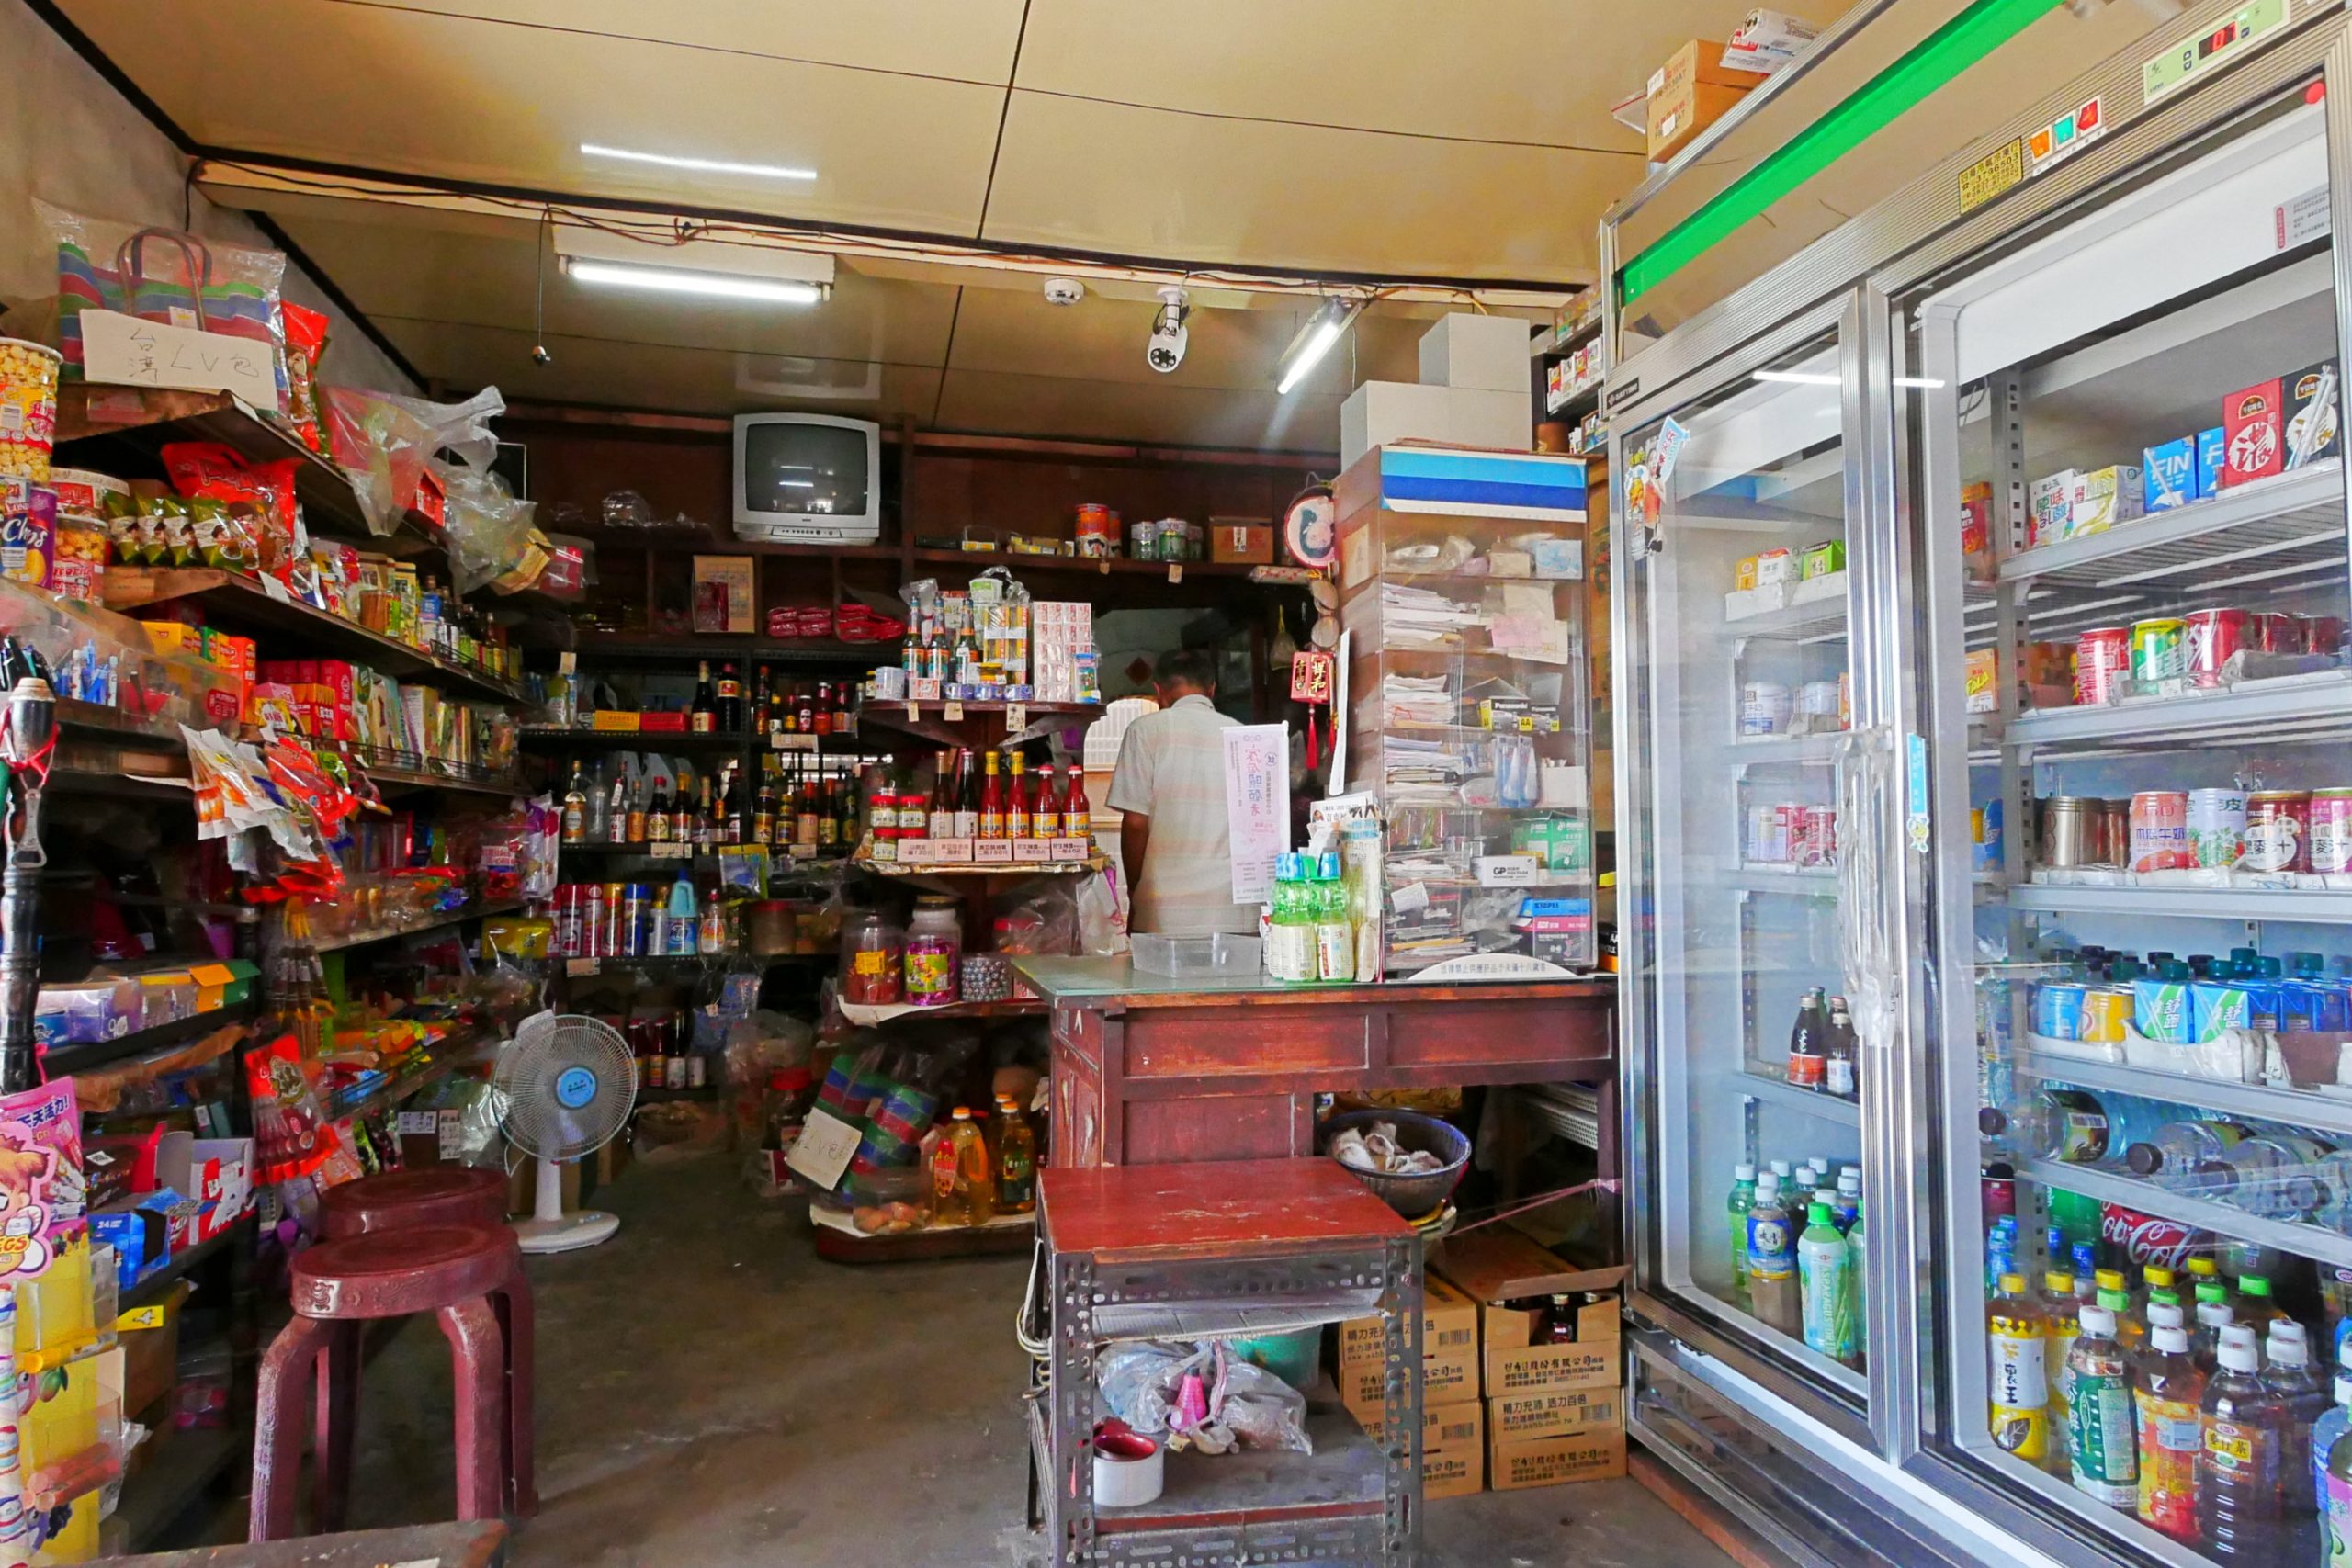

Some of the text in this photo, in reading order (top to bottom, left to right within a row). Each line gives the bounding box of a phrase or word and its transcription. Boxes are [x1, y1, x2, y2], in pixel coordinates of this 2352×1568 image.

[1493, 866, 1508, 876] GP
[1503, 1393, 1588, 1414] 精力充沛 活力百倍
